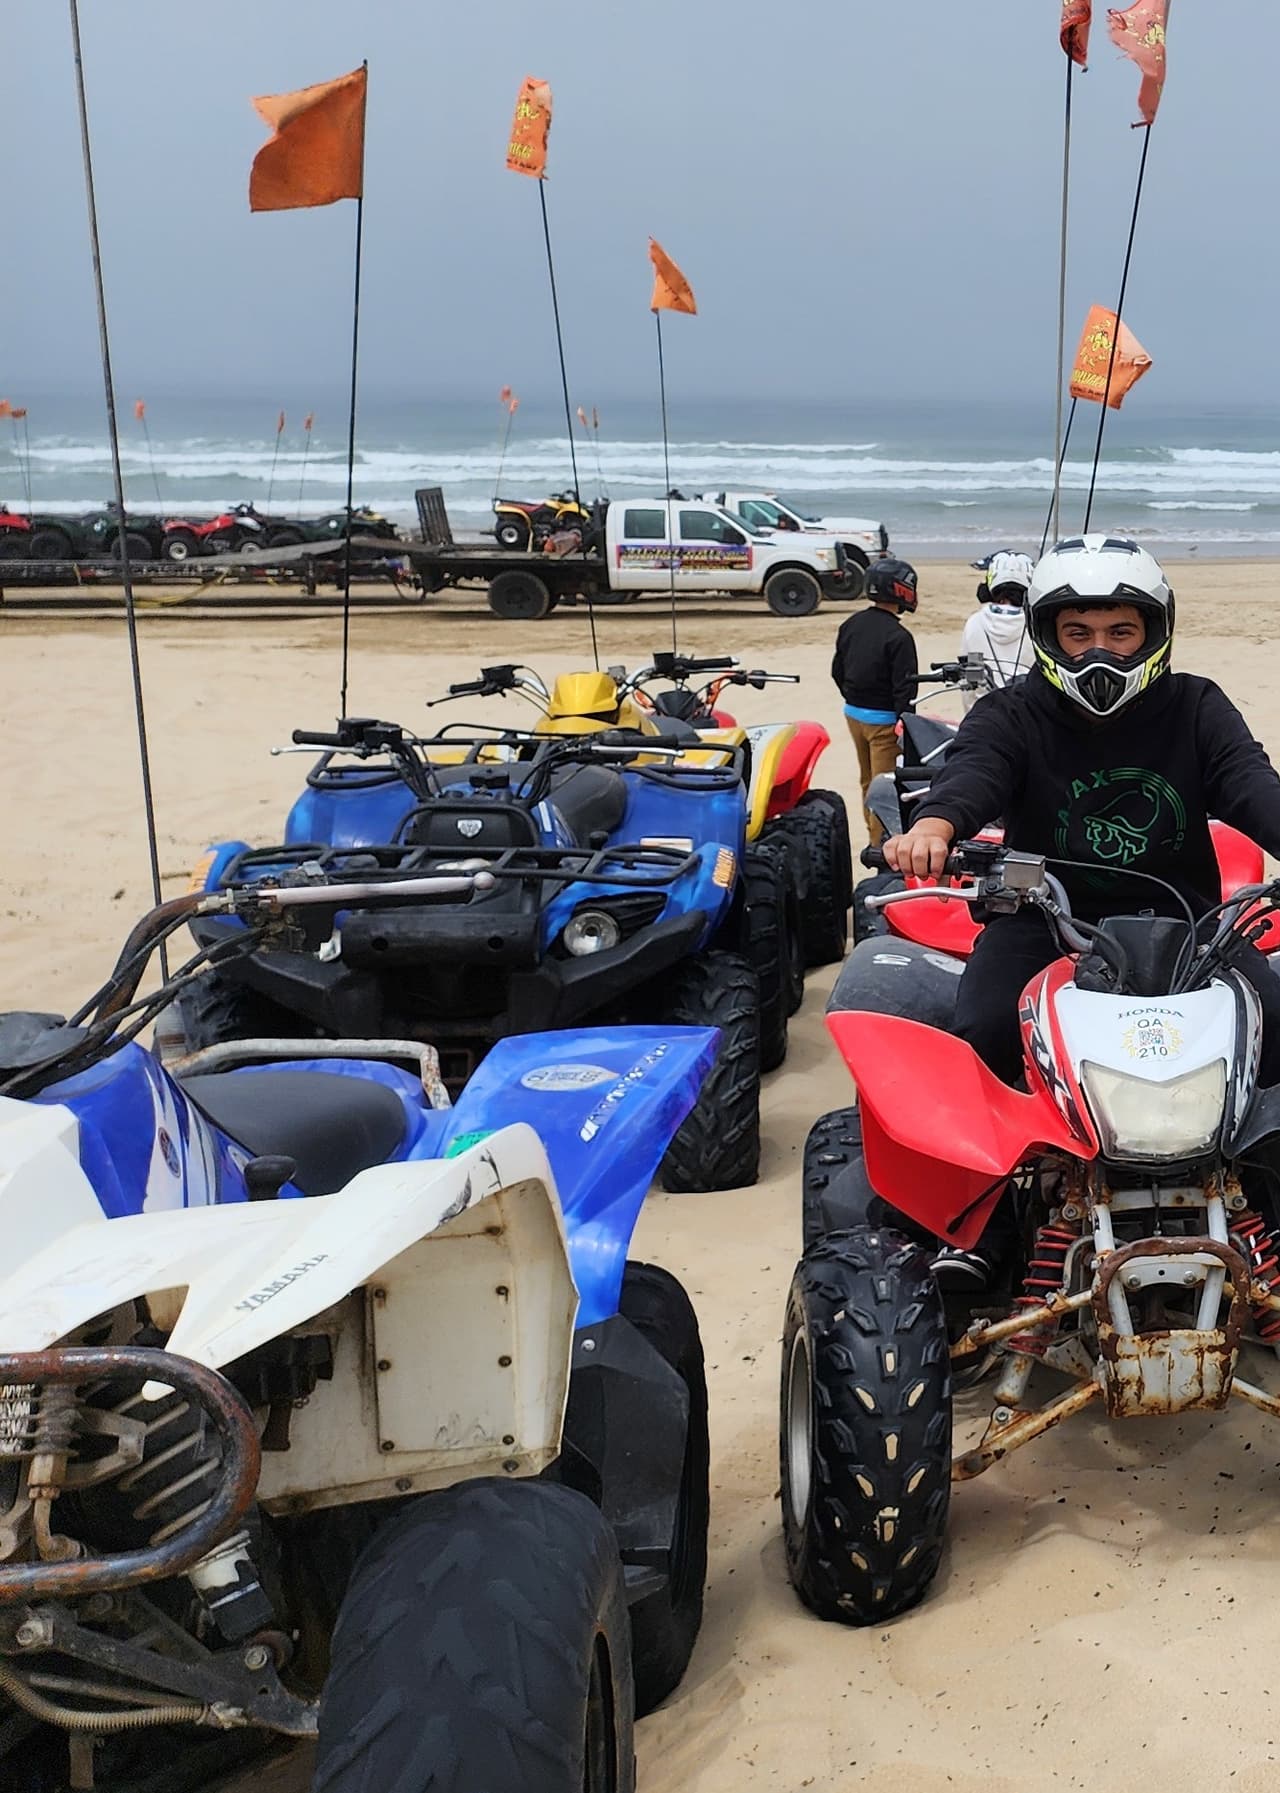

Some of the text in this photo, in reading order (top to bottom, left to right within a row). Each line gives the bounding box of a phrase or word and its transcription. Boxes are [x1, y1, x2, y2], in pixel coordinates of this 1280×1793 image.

[1118, 1007, 1185, 1019] HONDA
[1020, 996, 1071, 1100] TRX
[1139, 1046, 1168, 1059] 210
